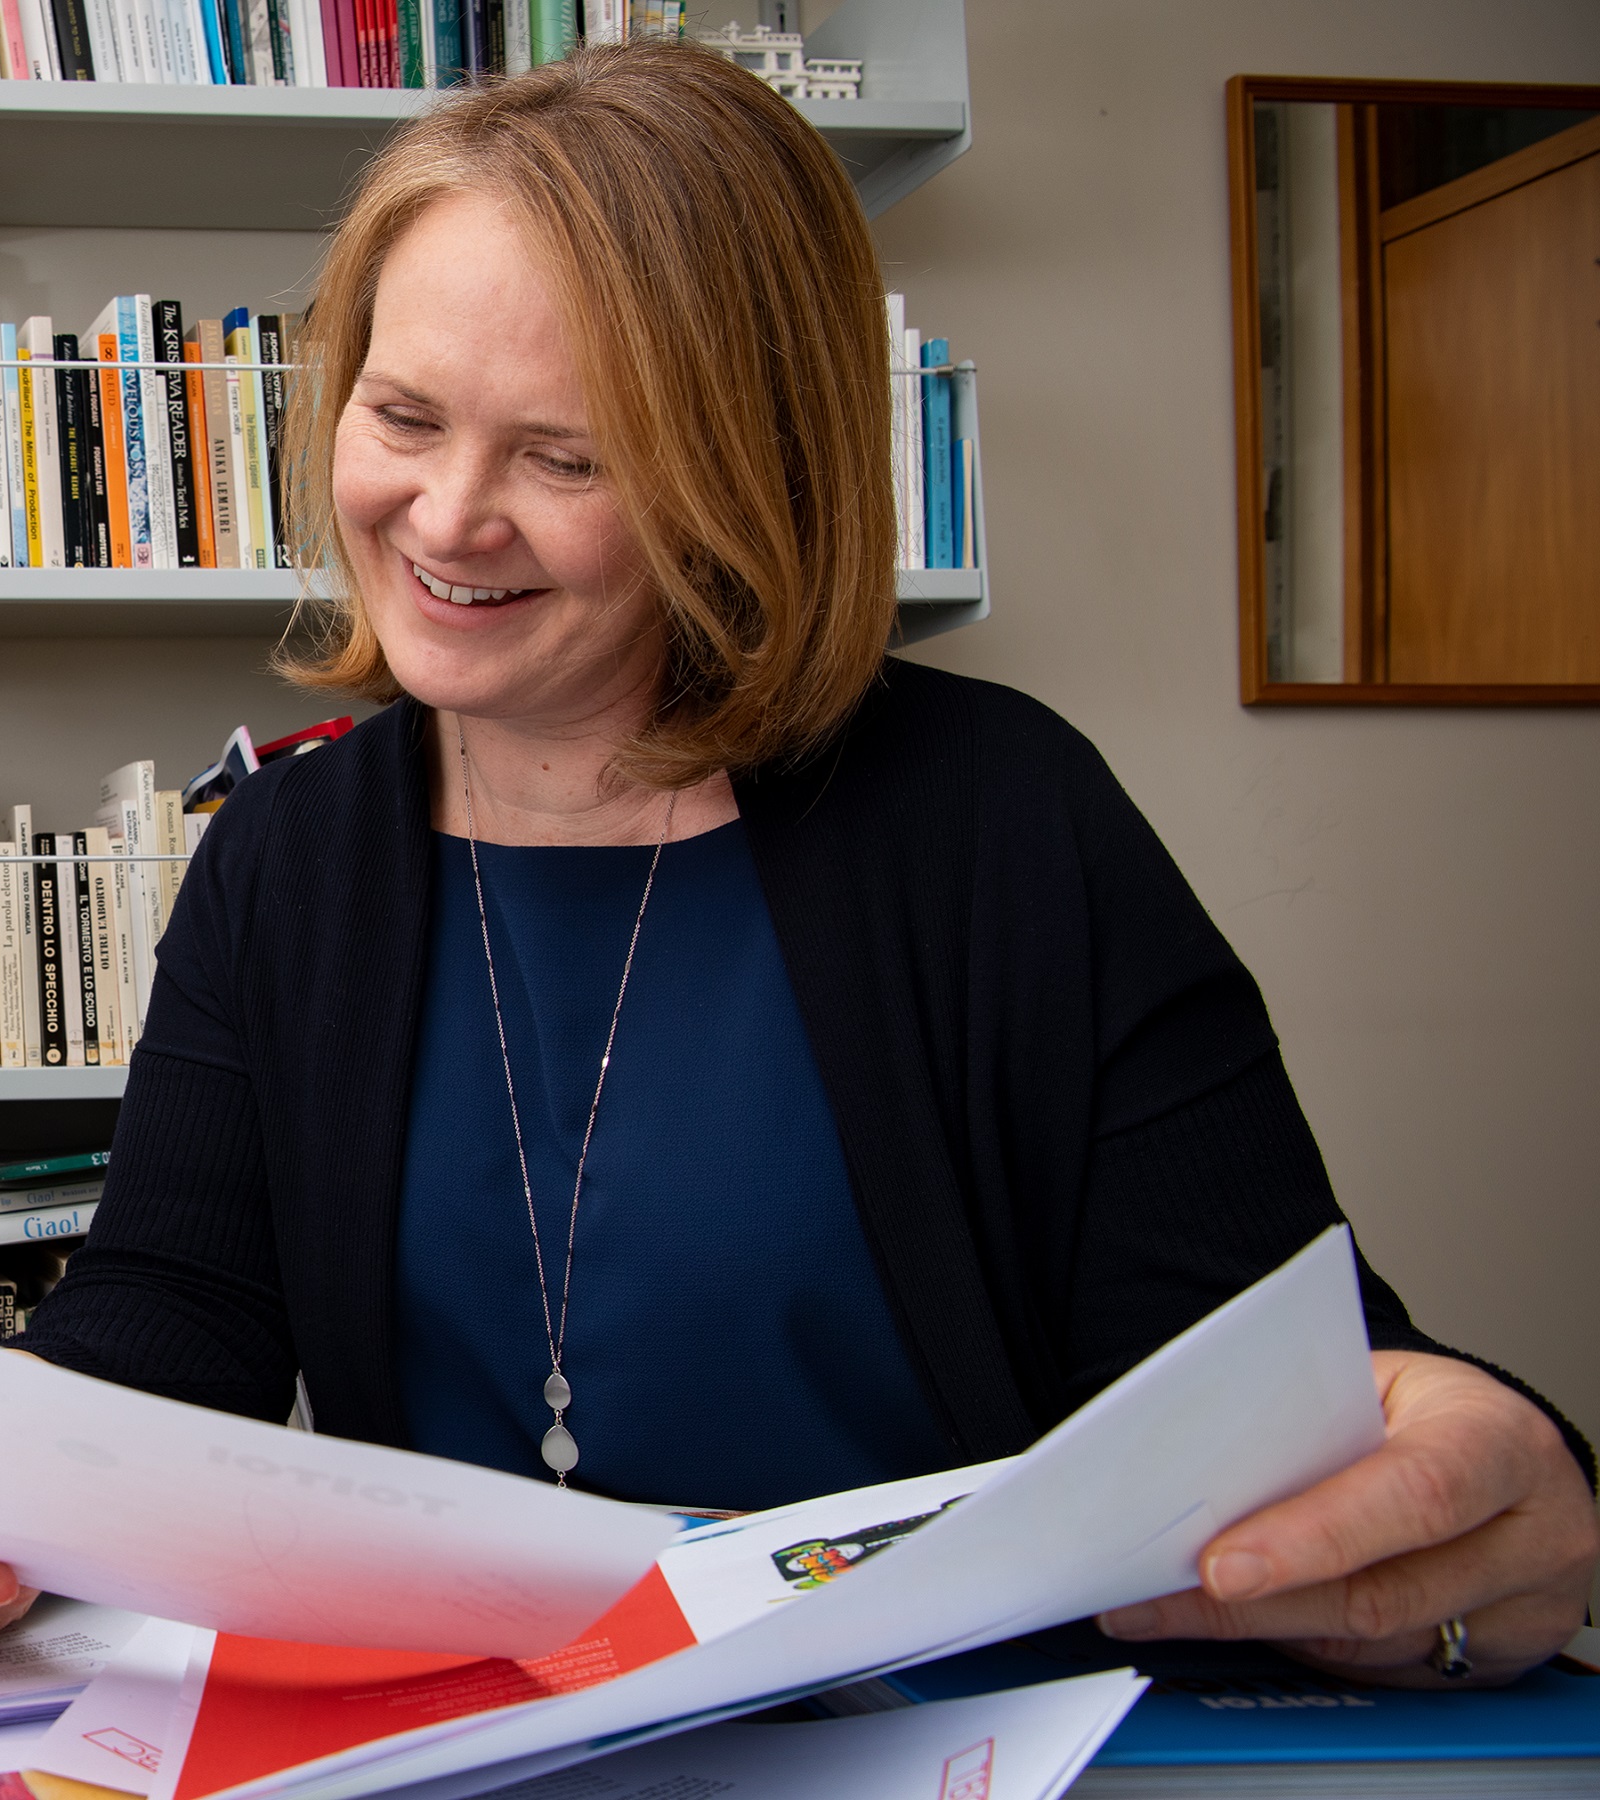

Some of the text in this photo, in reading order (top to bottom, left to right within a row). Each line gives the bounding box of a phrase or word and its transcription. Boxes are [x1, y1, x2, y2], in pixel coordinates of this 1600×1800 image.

[140, 301, 151, 337] Reading
[65, 375, 75, 393] Paul
[88, 368, 98, 393] MICHEL
[273, 370, 283, 410] LYOTARD
[89, 393, 100, 428] FOUCAULT
[210, 380, 223, 416] LACAN
[67, 427, 78, 439] THE
[162, 304, 190, 529] The KRISEVA READER Toril Moi
[68, 441, 80, 473] FOUCAULT
[92, 446, 103, 480] FOUCAULT
[25, 420, 40, 541] The Mirror of Production
[70, 475, 81, 500] READER
[95, 480, 105, 496] LIVE
[214, 439, 231, 536] ANIKA LEMAIRE
[125, 809, 136, 874] NATURALE SEI
[131, 809, 140, 845] BUONANNO
[165, 800, 181, 890] Rossana Rossnda LE
[22, 871, 31, 893] STATO
[114, 862, 122, 886] FRANCA
[23, 893, 31, 903] DI
[0, 898, 15, 933] parola
[24, 902, 33, 936] FAMIGLIA
[94, 876, 111, 971] OLTRE L'ABORTO
[2, 933, 14, 949] La
[41, 879, 59, 1034] DENTRO LO SPECCHIO
[79, 862, 97, 1029] Conti IL TORMENTO E LO SCUDO
[26, 1190, 56, 1205] Ciao!
[23, 1211, 80, 1239] Ciao!
